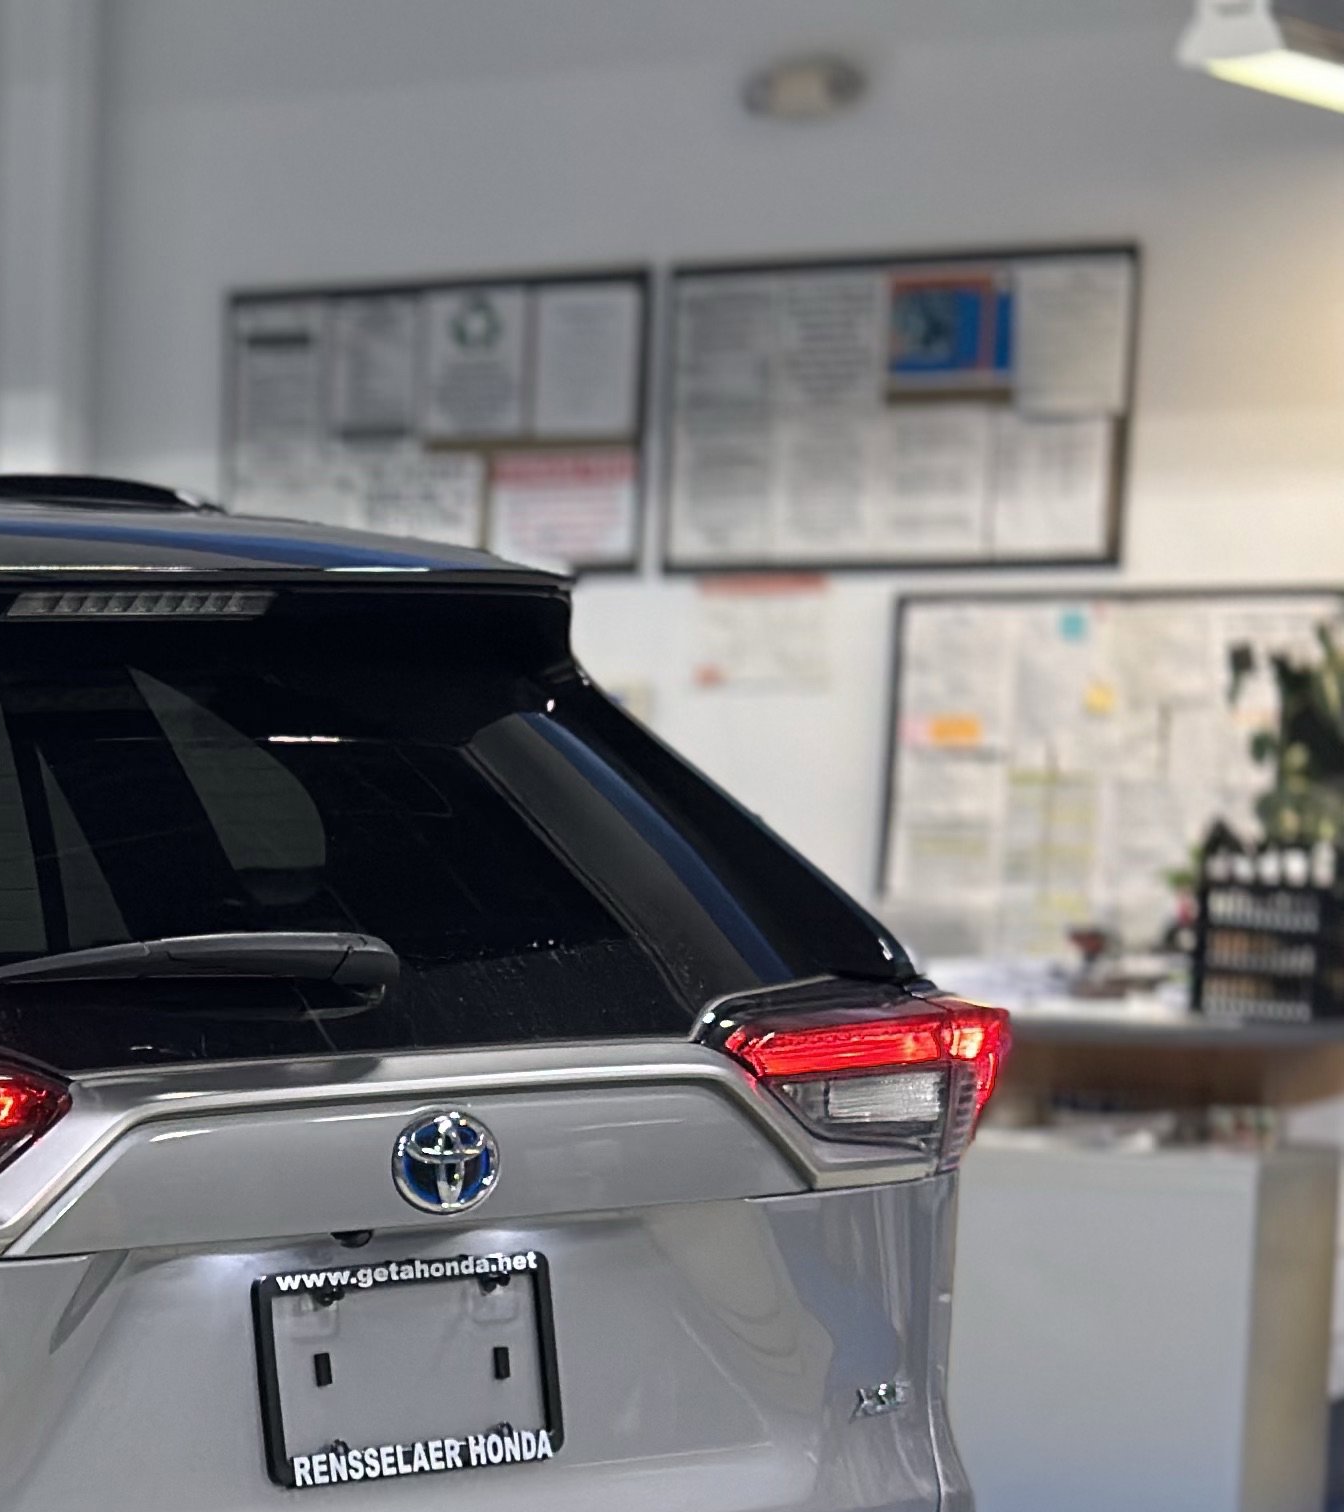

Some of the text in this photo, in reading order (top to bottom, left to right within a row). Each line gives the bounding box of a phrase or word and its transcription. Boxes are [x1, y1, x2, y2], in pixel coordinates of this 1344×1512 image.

[275, 1251, 537, 1291] www.getahonda.net
[293, 1430, 553, 1487] RENSSELAER HONDA
